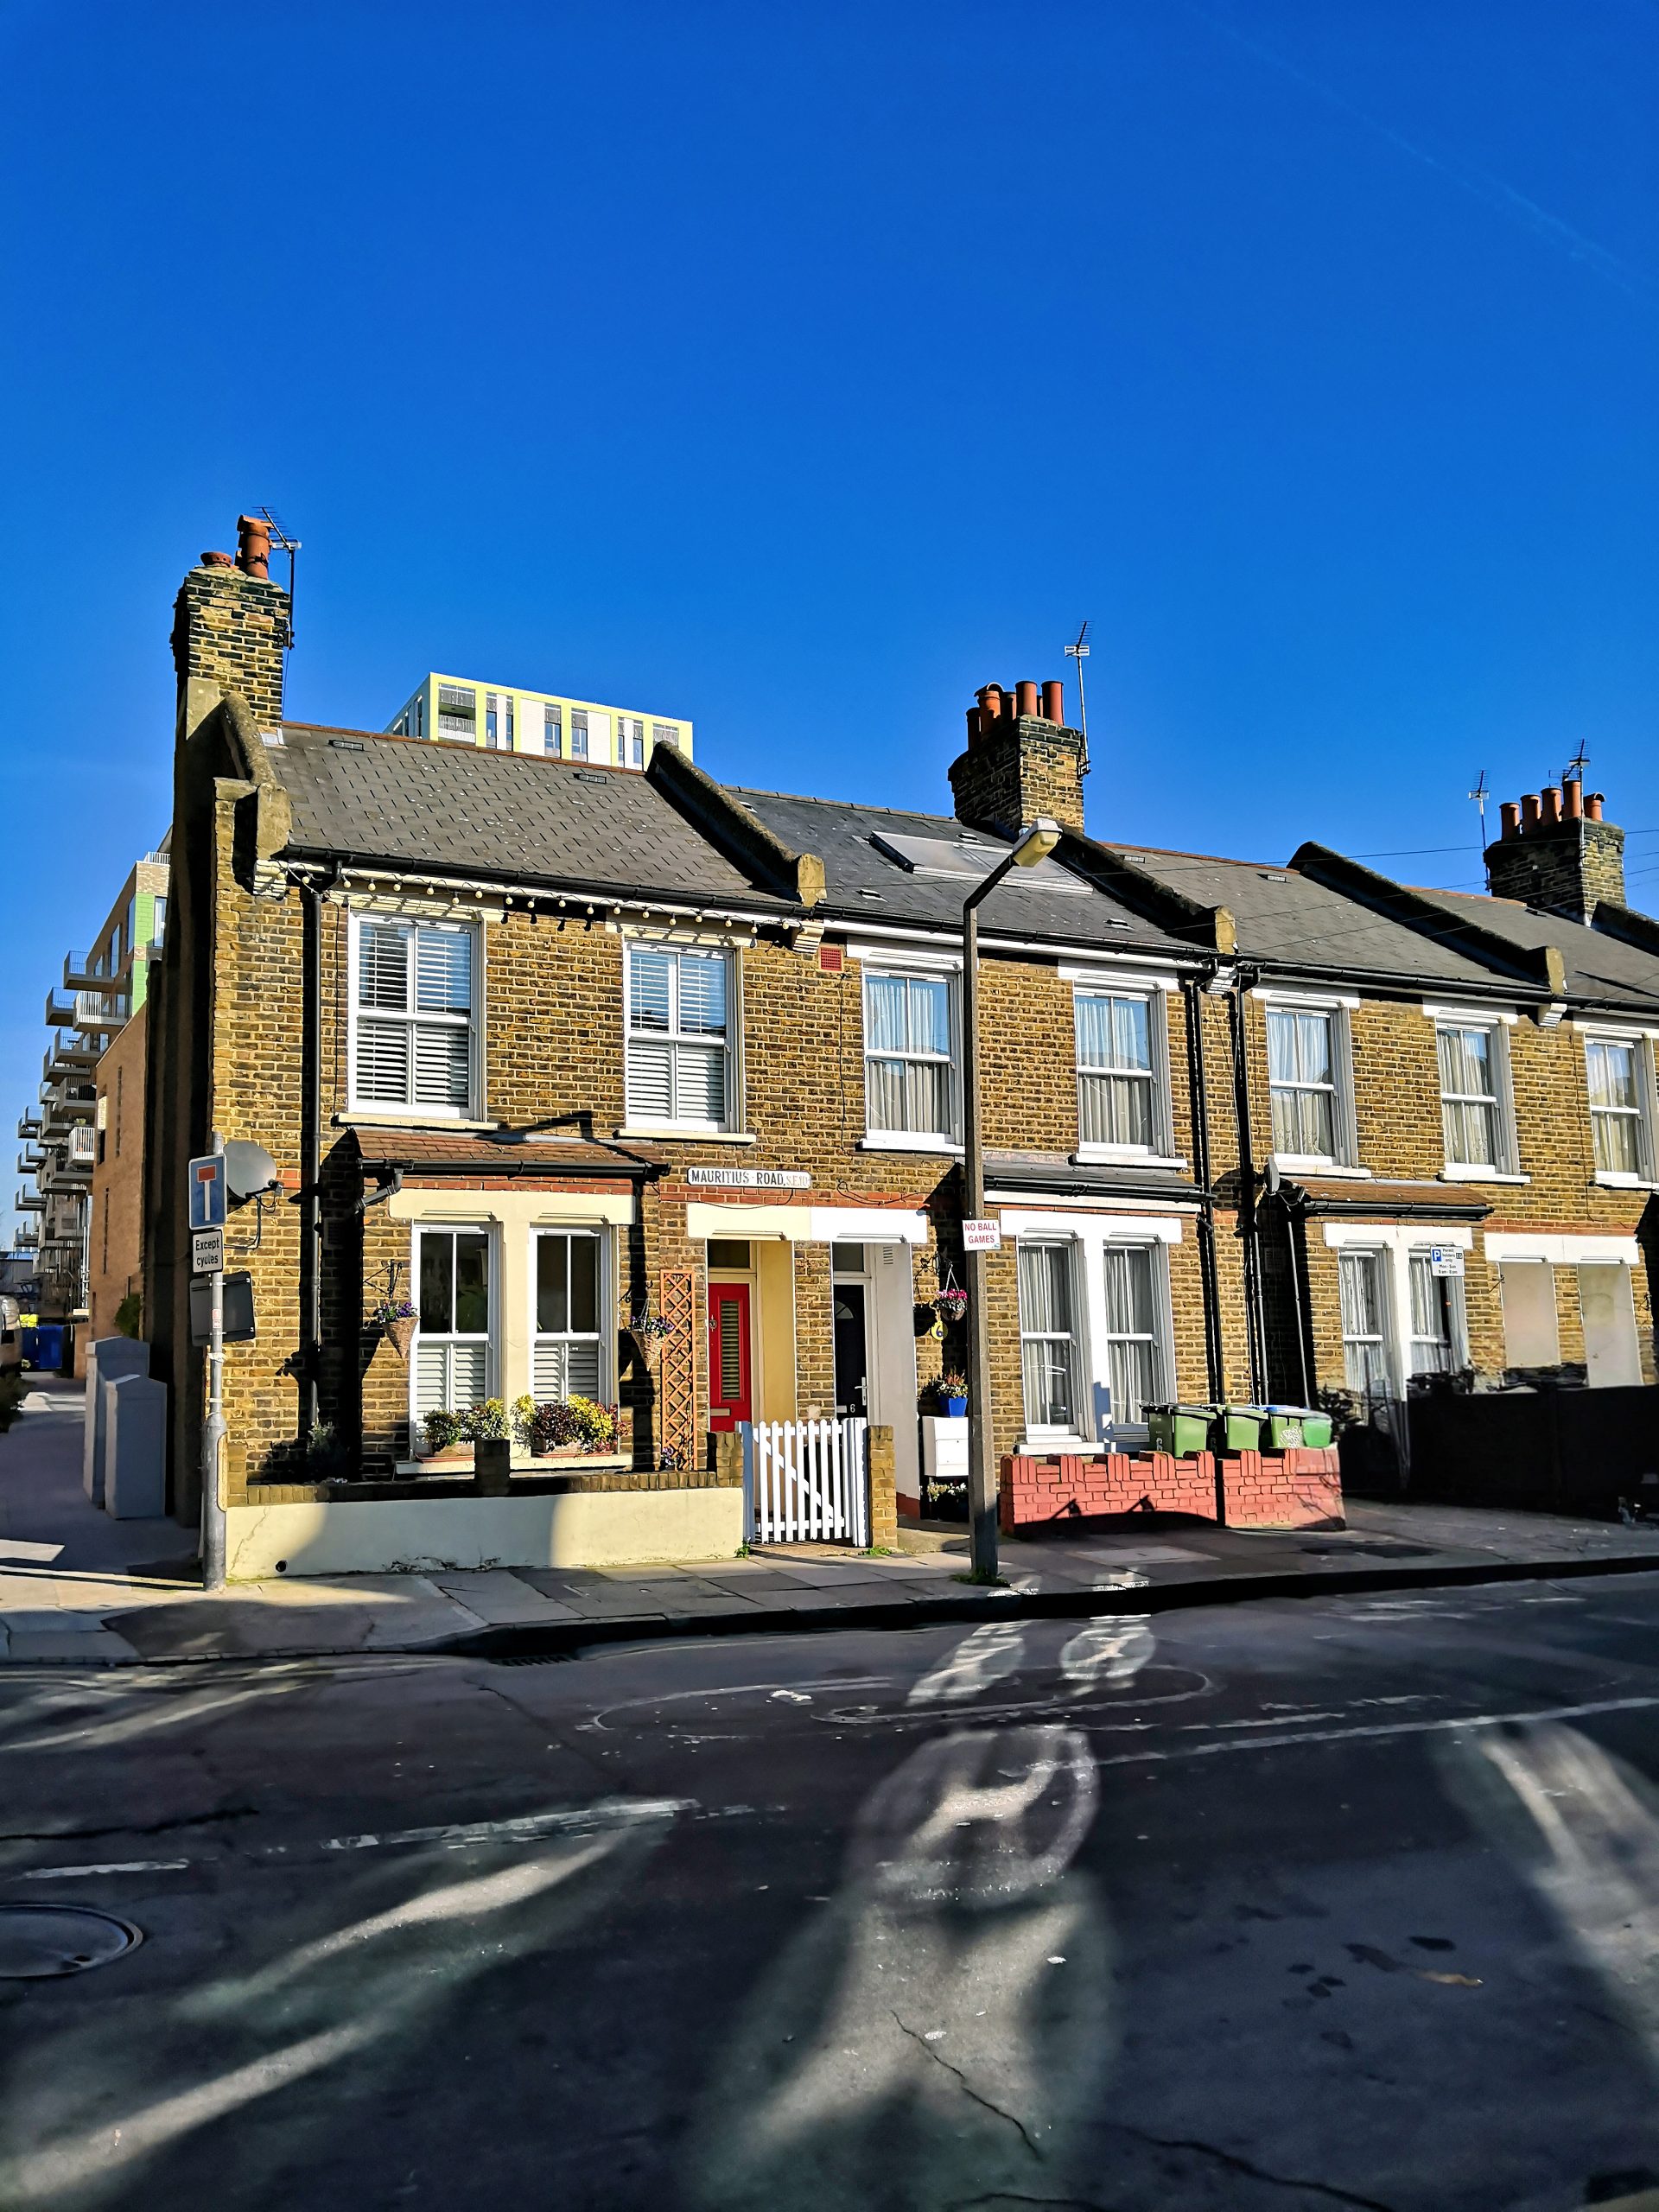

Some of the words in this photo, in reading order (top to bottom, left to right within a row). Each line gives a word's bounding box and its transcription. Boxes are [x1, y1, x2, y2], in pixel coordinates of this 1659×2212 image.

[691, 1170, 749, 1184] MAURITIUS
[964, 1223, 976, 1231] NO
[977, 1223, 997, 1231] BALL
[195, 1237, 219, 1251] Except
[968, 1235, 995, 1243] GAMES
[196, 1255, 219, 1268] cycles
[936, 1325, 944, 1337] 6
[850, 1403, 855, 1413] 6
